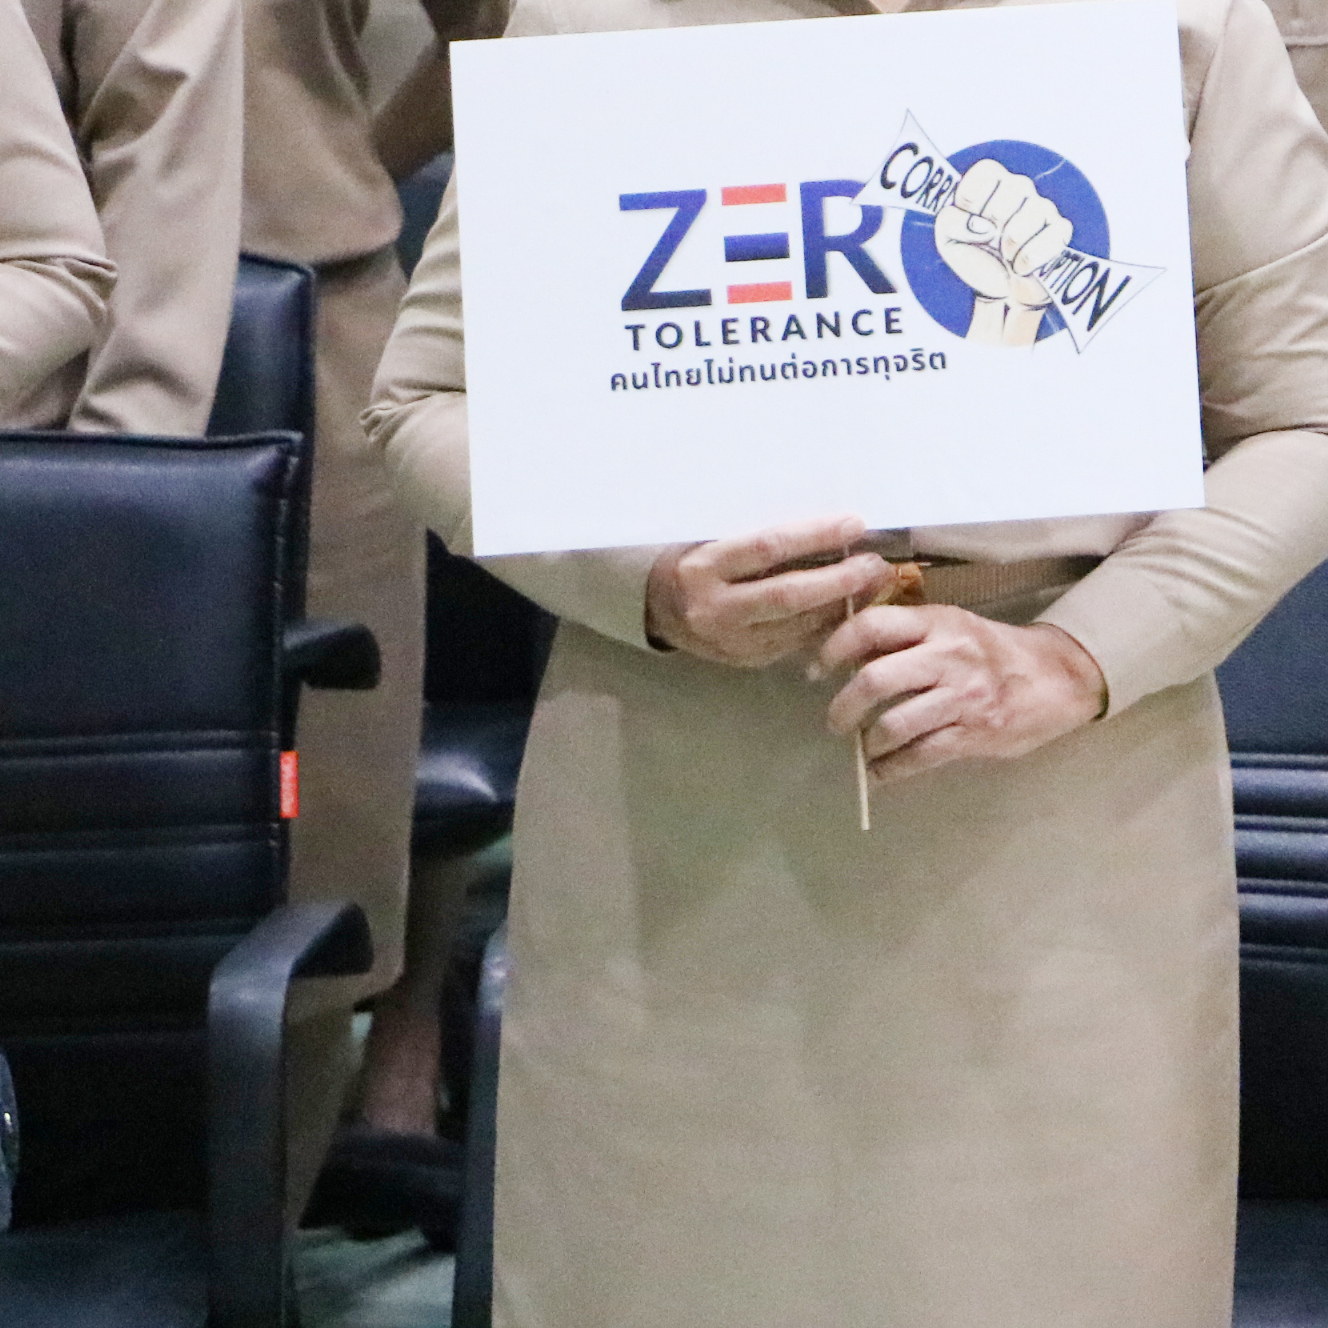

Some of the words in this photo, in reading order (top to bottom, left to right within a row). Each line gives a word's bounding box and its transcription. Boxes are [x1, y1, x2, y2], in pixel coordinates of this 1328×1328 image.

[623, 306, 905, 352] TOLERANCE
[609, 347, 947, 392] คนไทยไม่ทนต่อการทุจริต
